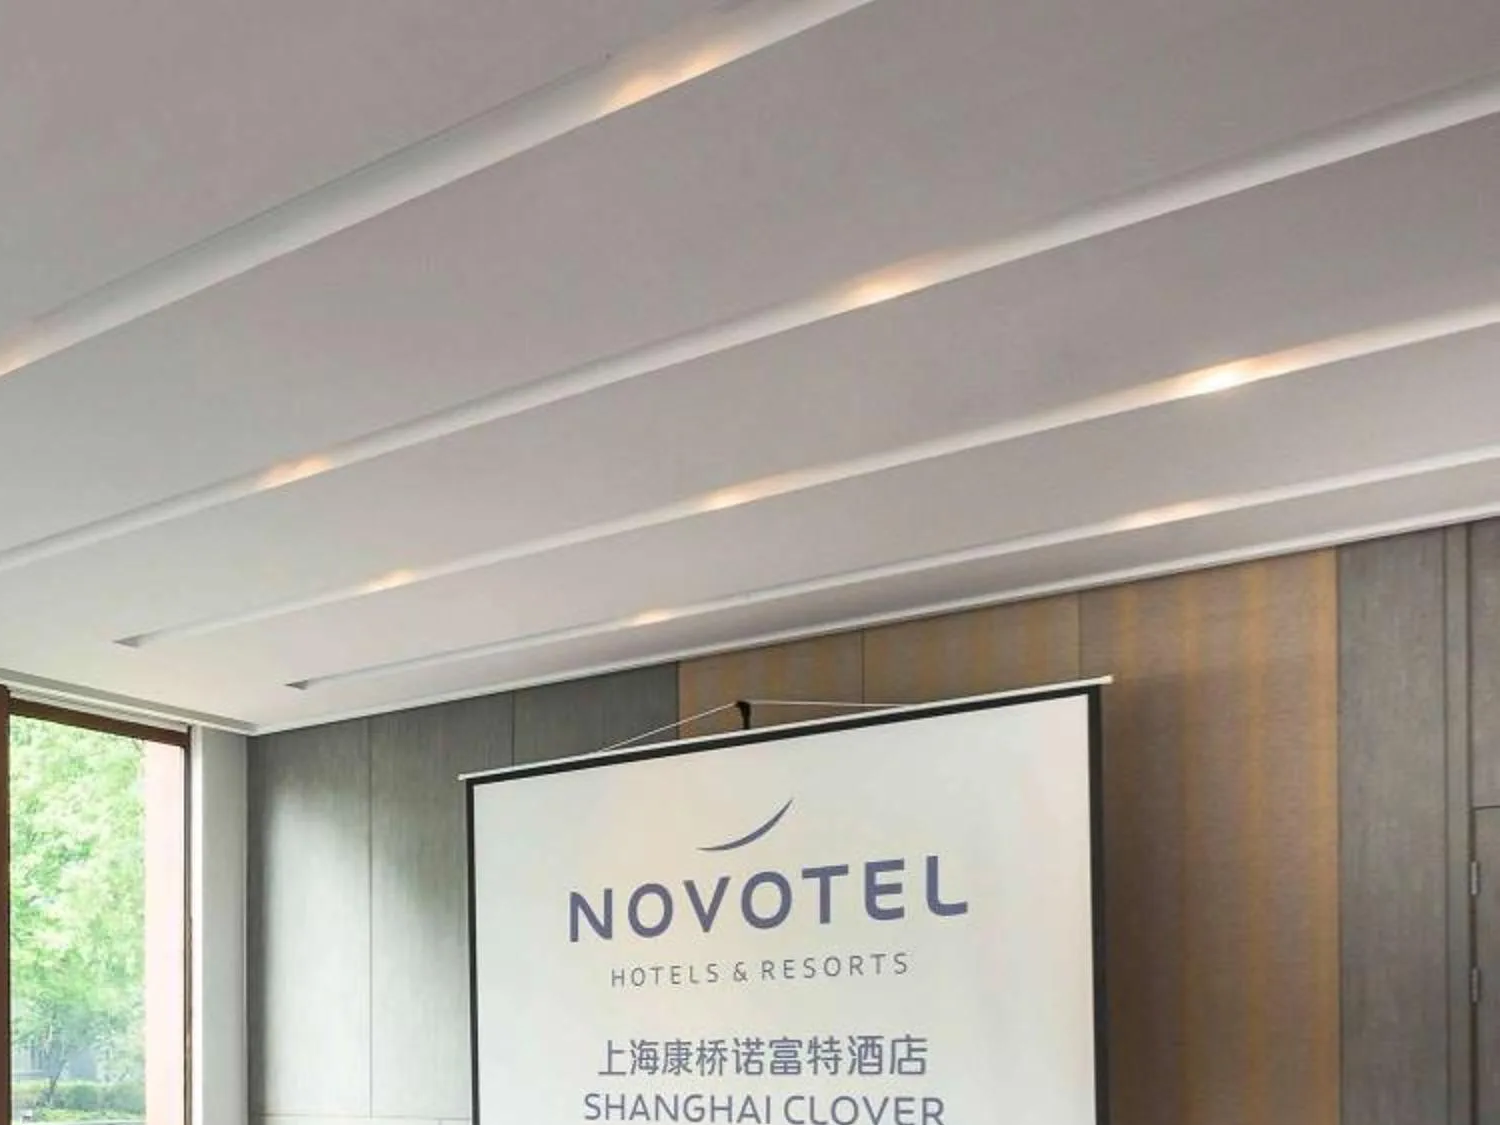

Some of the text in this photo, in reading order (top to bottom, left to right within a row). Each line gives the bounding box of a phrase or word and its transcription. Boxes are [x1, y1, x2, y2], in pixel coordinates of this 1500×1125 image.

[569, 855, 969, 943] NOVOTEL
[611, 952, 908, 988] HOTELS & RESORTS
[597, 1033, 929, 1078] 上海康桥诺富特酒店
[583, 1092, 772, 1125] SHANGHAI
